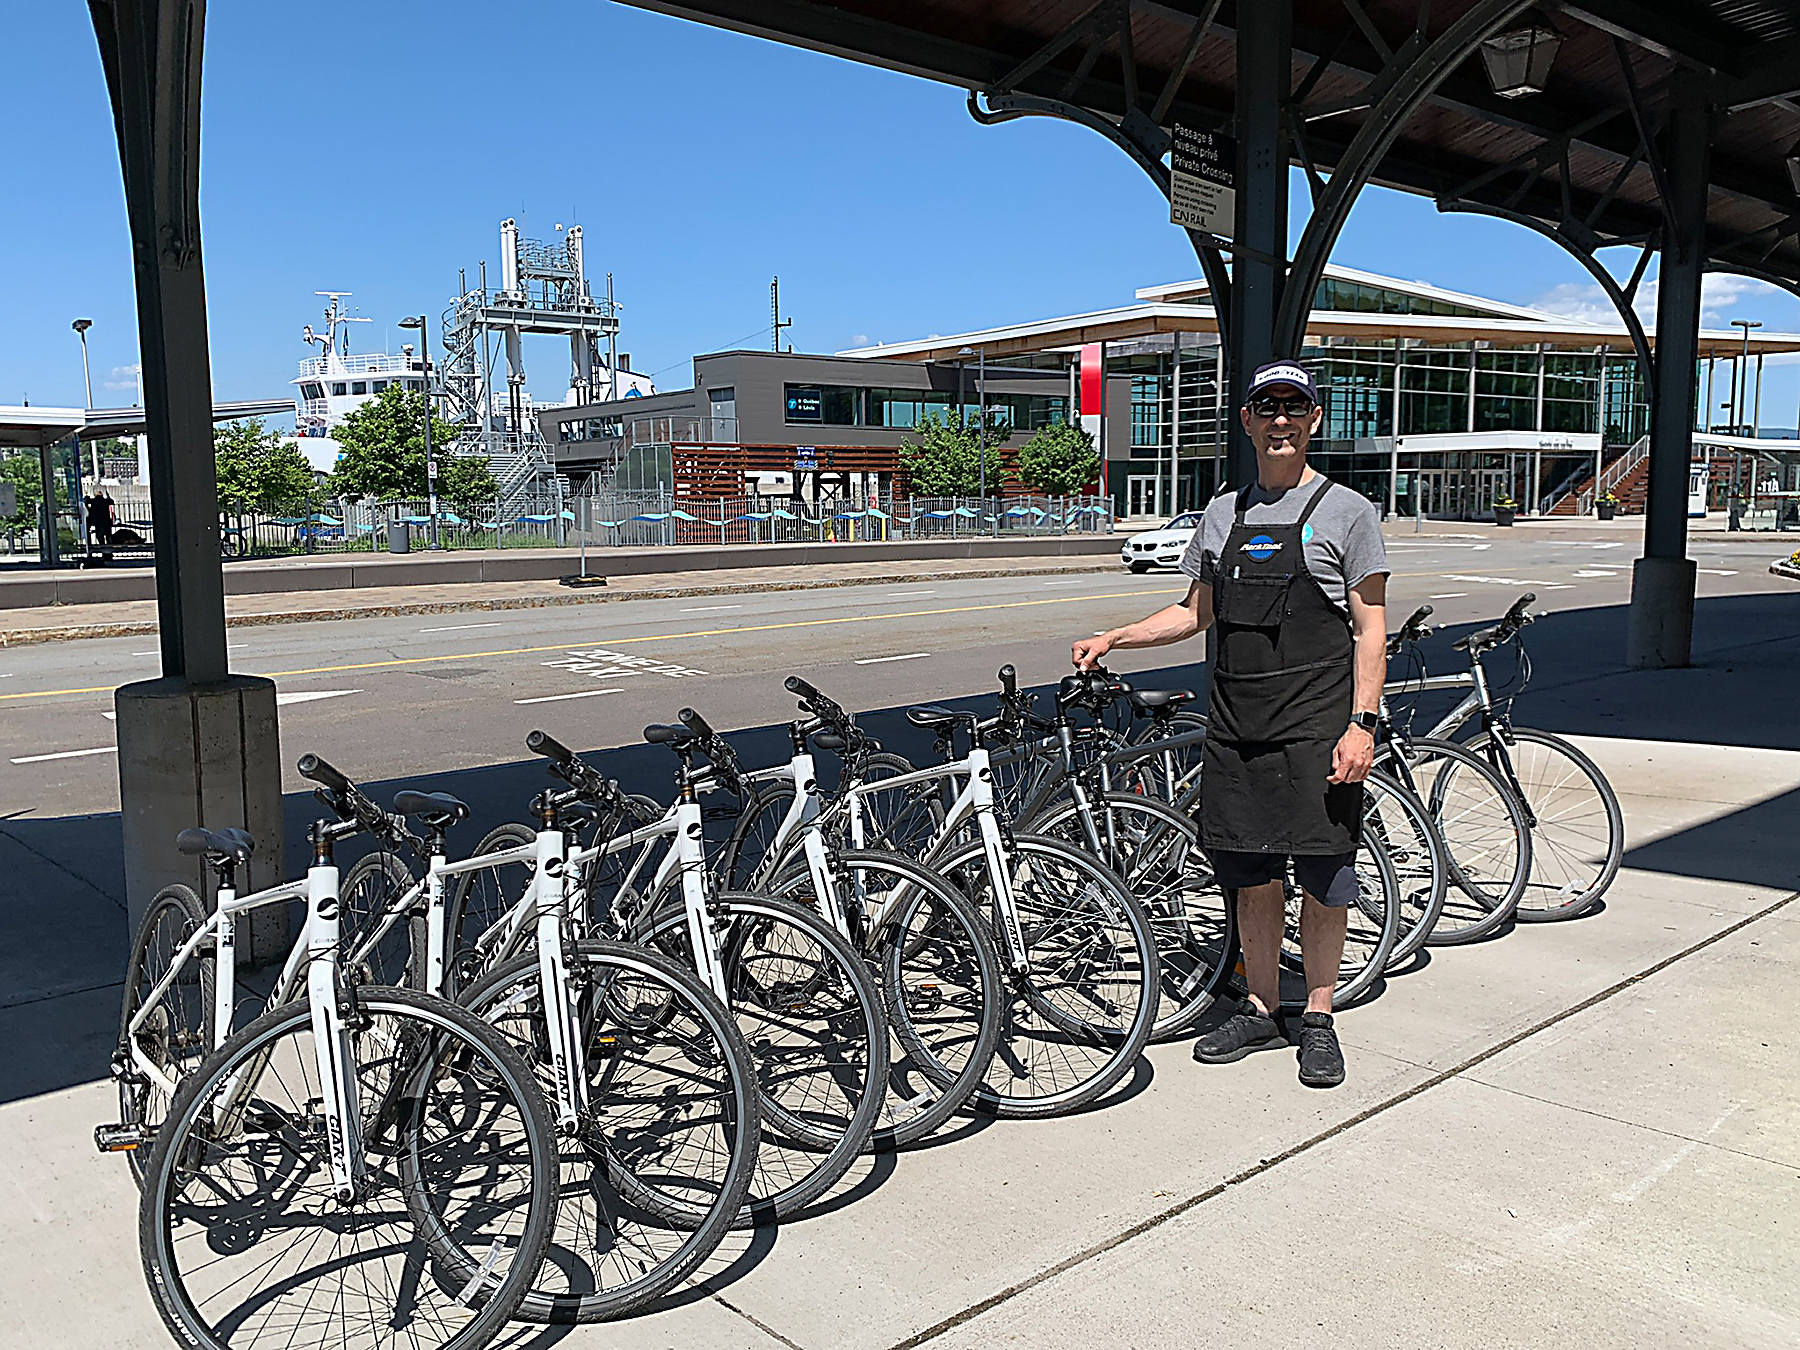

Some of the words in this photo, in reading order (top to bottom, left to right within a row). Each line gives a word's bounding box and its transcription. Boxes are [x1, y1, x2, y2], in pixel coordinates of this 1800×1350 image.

[1174, 122, 1207, 144] Passage
[1174, 138, 1198, 155] niveau
[1199, 148, 1218, 162] privé
[1174, 154, 1200, 172] Private
[1201, 162, 1233, 185] Crossing
[539, 656, 644, 679] TAXI
[566, 649, 665, 668] ZONE
[642, 664, 710, 679] DE
[1005, 914, 1024, 958] GIANT
[555, 1053, 572, 1111] GIANT
[329, 1114, 347, 1178] GIANT
[666, 1250, 697, 1280] GIANT
[169, 1311, 200, 1346] GIANT
